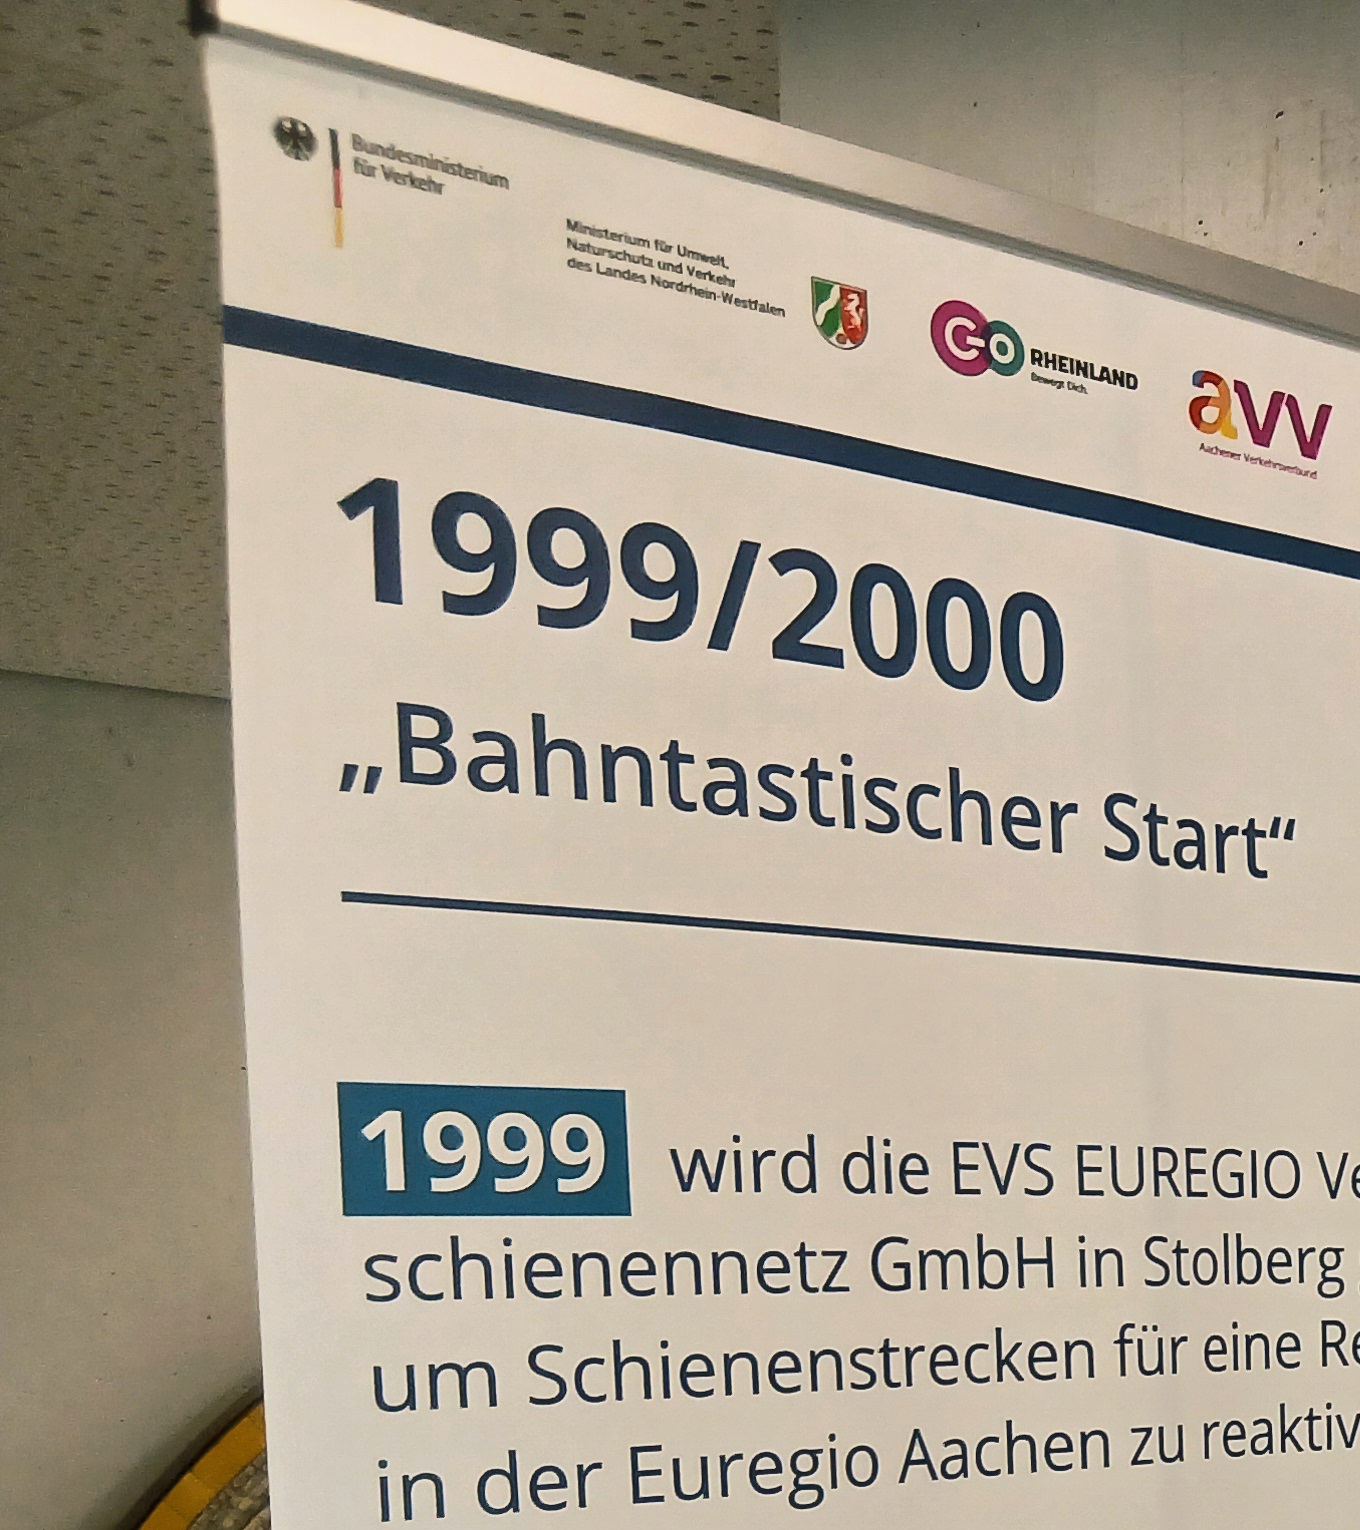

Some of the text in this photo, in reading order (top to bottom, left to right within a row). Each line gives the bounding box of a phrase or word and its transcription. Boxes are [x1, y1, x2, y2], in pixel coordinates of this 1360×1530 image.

[352, 133, 509, 190] Bundesministerium
[354, 157, 446, 195] für Verkehr
[566, 218, 650, 249] Ministerium
[654, 239, 673, 254] für
[566, 237, 736, 288] Naturschutz und Verkehr
[567, 257, 786, 318] des Landes Nordrhein-Westfalen
[1030, 348, 1139, 391] RHEINLAND
[1199, 442, 1318, 481] Aachener Verkehrsverbund
[337, 478, 1065, 702] 1999/2000
[339, 702, 1295, 880] „Bahntastischer Start“
[360, 1110, 605, 1194] 1999
[671, 1134, 818, 1194] wird
[842, 1136, 930, 1195] die
[953, 1141, 1055, 1197] EVS
[1077, 1144, 1302, 1200] EUREGIO
[364, 1235, 850, 1303] schienennetz
[871, 1233, 1056, 1293] GmbH
[1078, 1235, 1125, 1288] in
[1143, 1233, 1345, 1299] Stolberg
[373, 1362, 498, 1413] um
[527, 1327, 1096, 1405] Schienenstrecken
[1114, 1323, 1188, 1378] für
[1203, 1322, 1302, 1373] eine
[377, 1459, 446, 1523] in
[477, 1450, 603, 1515] der
[630, 1434, 879, 1509] Euregio
[900, 1420, 1110, 1485] Aachen
[1130, 1423, 1185, 1466] zu
